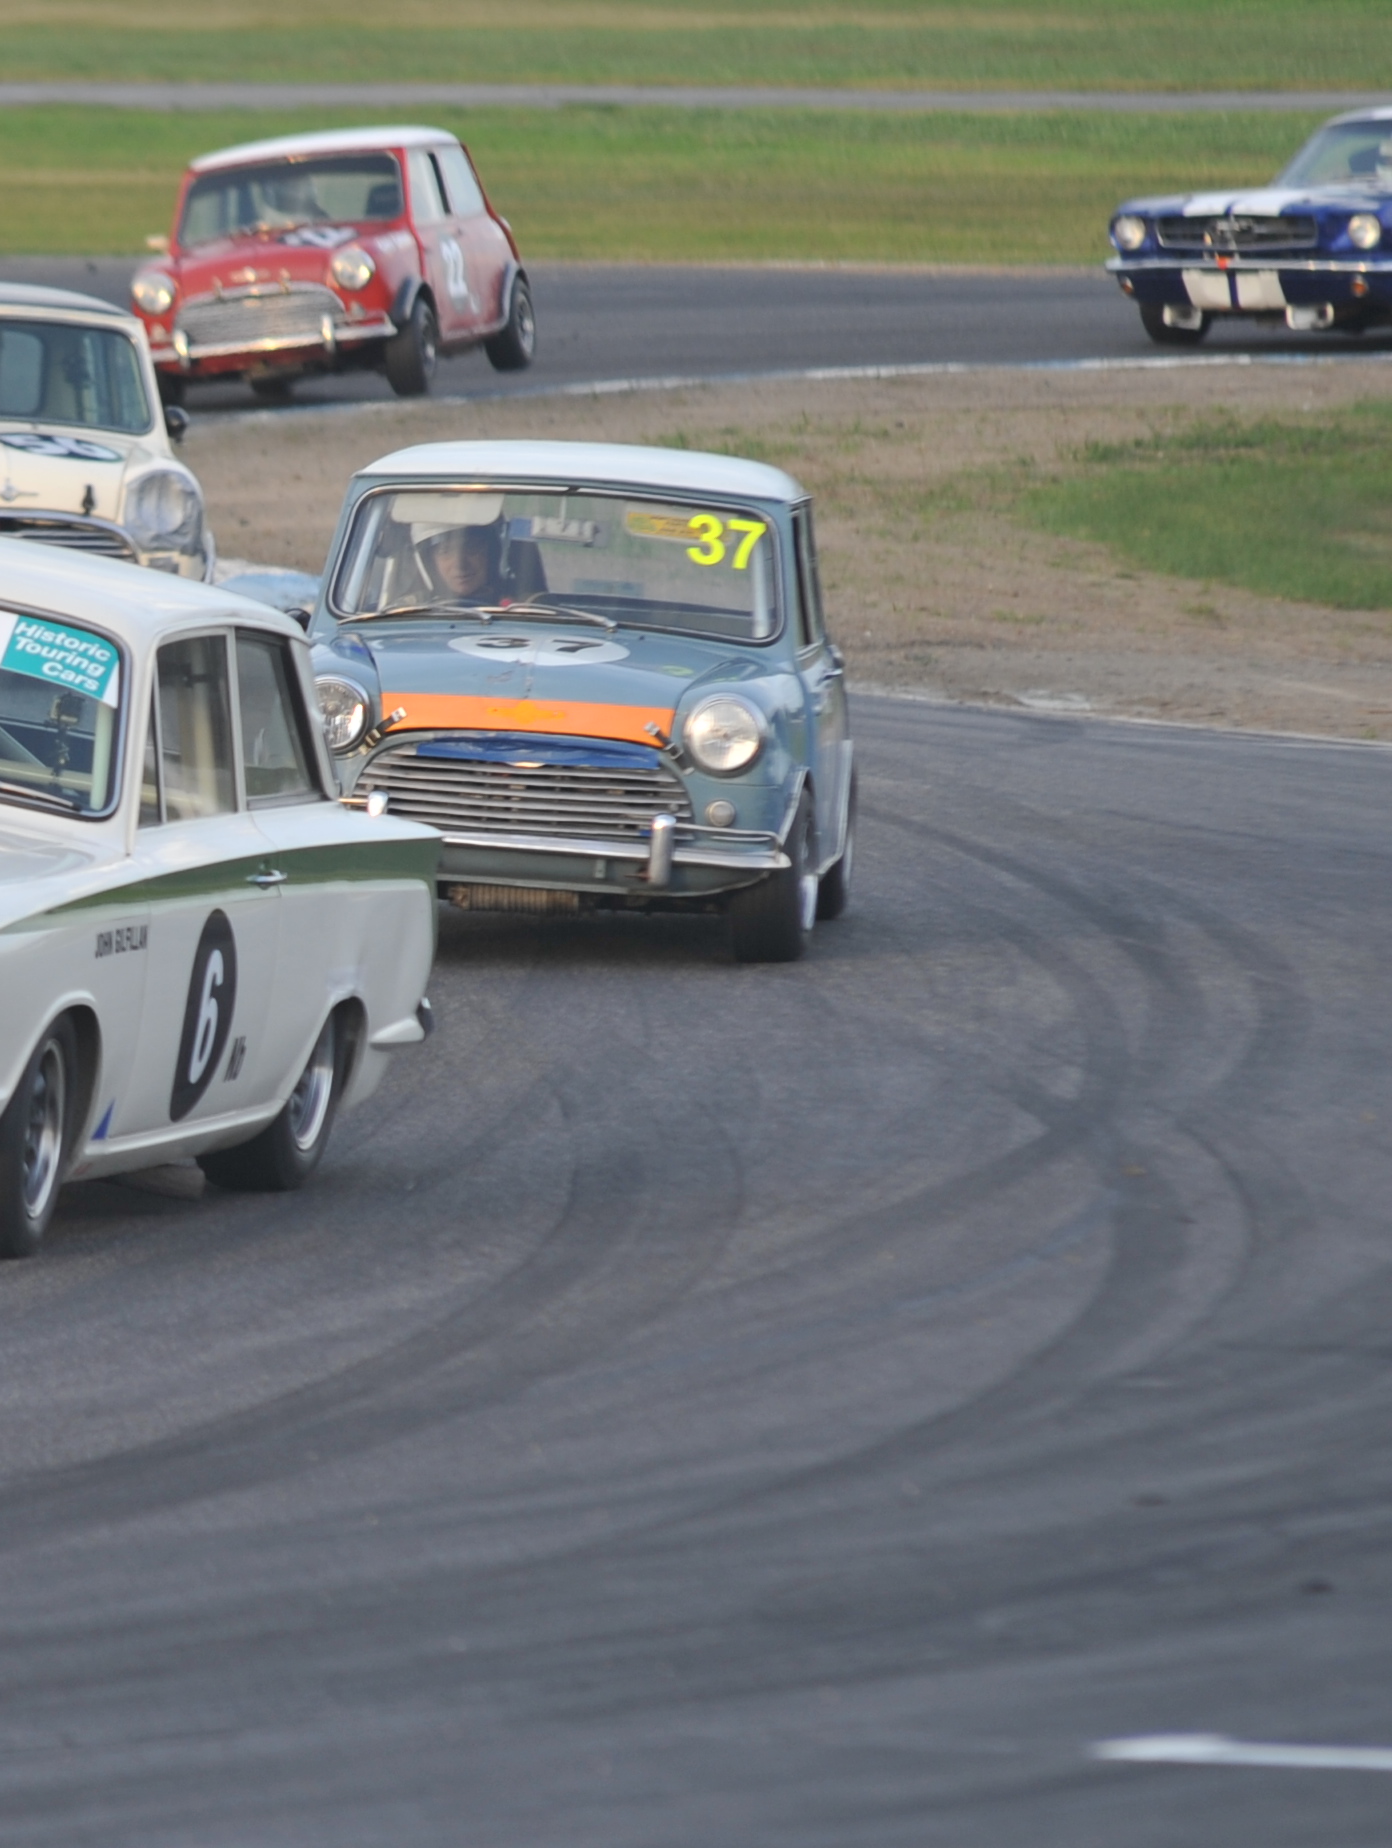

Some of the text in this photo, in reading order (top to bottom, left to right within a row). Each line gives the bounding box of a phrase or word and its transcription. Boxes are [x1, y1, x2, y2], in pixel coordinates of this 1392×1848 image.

[686, 513, 768, 569] 37
[14, 621, 111, 662] Historic
[15, 636, 106, 678] Touring
[476, 636, 604, 654] 37
[42, 661, 100, 691] Cars
[187, 949, 224, 1085] 6
